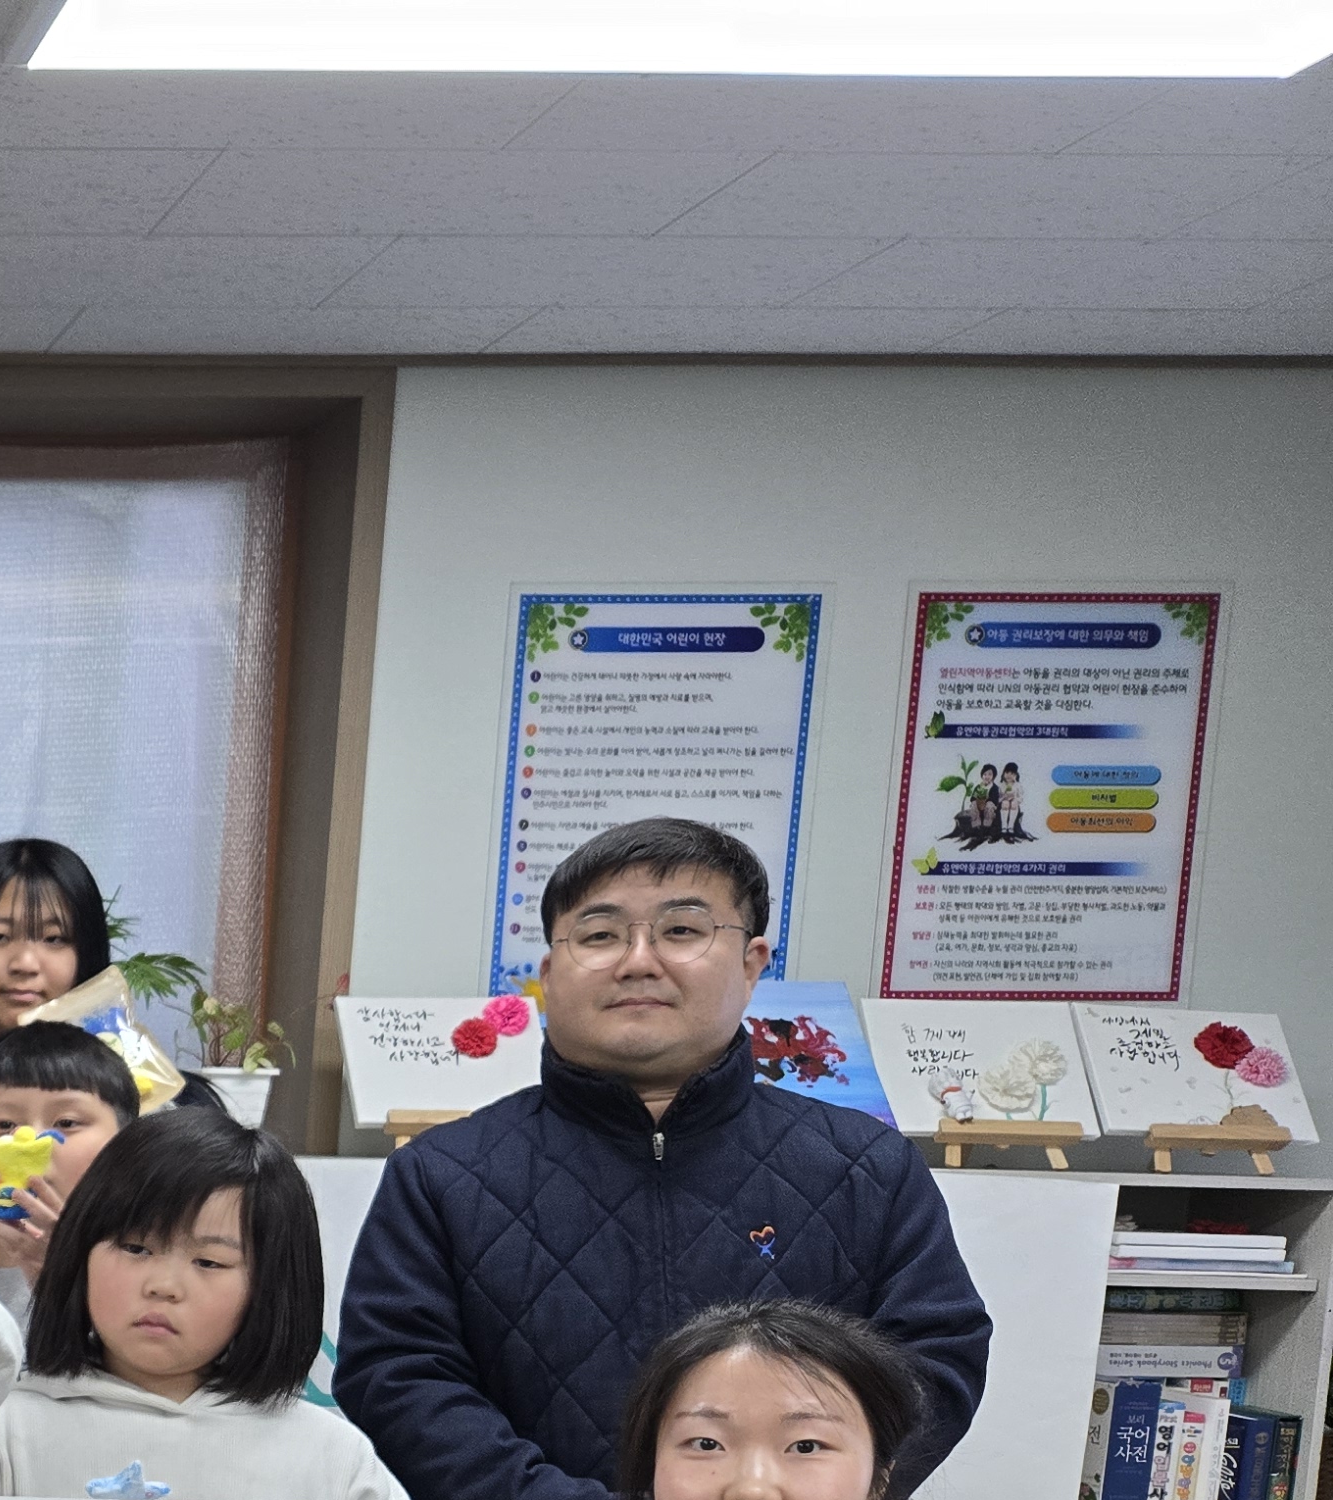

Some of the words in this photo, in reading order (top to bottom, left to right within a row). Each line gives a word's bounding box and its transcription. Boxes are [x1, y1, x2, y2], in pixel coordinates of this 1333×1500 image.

[617, 632, 662, 647] 대한민국
[667, 632, 699, 647] 어린이
[1116, 1426, 1151, 1445] 국어
[1114, 1444, 1148, 1463] 사전
